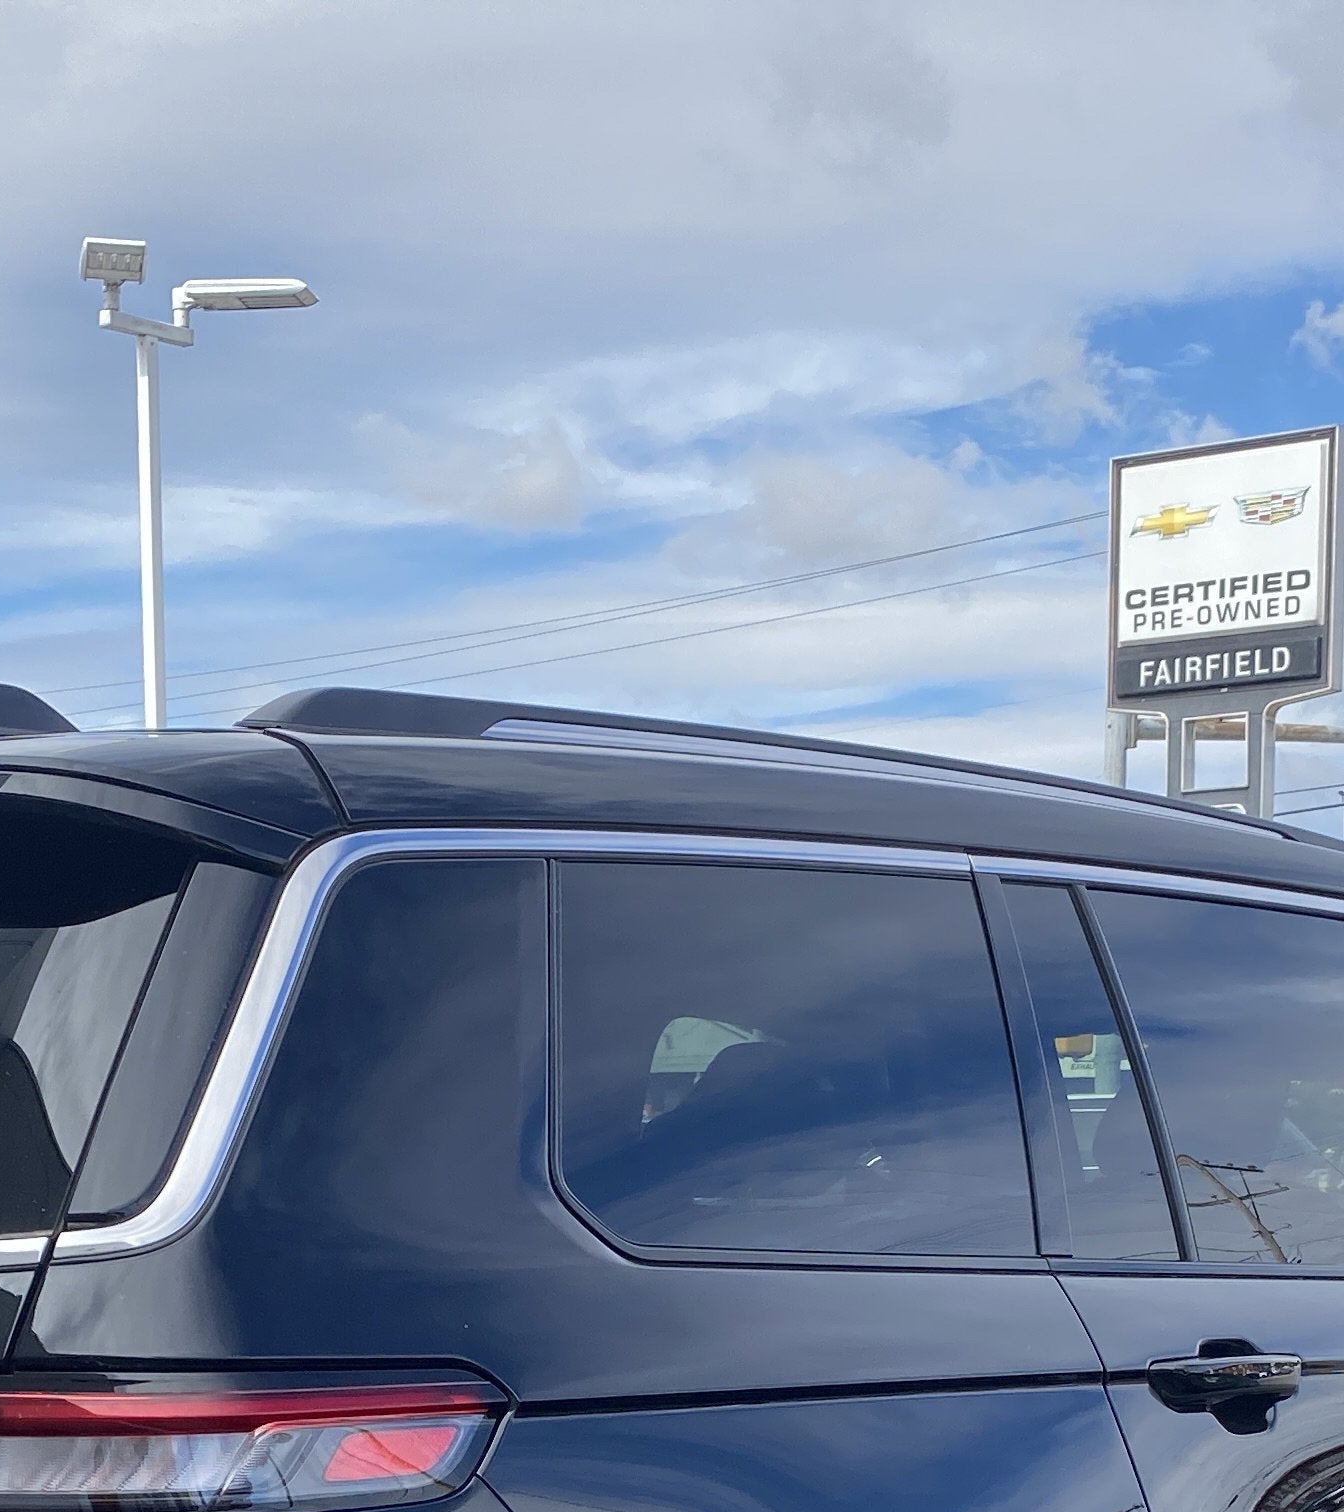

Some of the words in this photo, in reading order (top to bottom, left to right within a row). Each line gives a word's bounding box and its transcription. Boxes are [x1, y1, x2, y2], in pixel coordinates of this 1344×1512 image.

[1125, 569, 1311, 611] CERTIFIED
[1133, 595, 1301, 633] PRE-OWNED
[1139, 646, 1291, 688] FAIRFIELD
